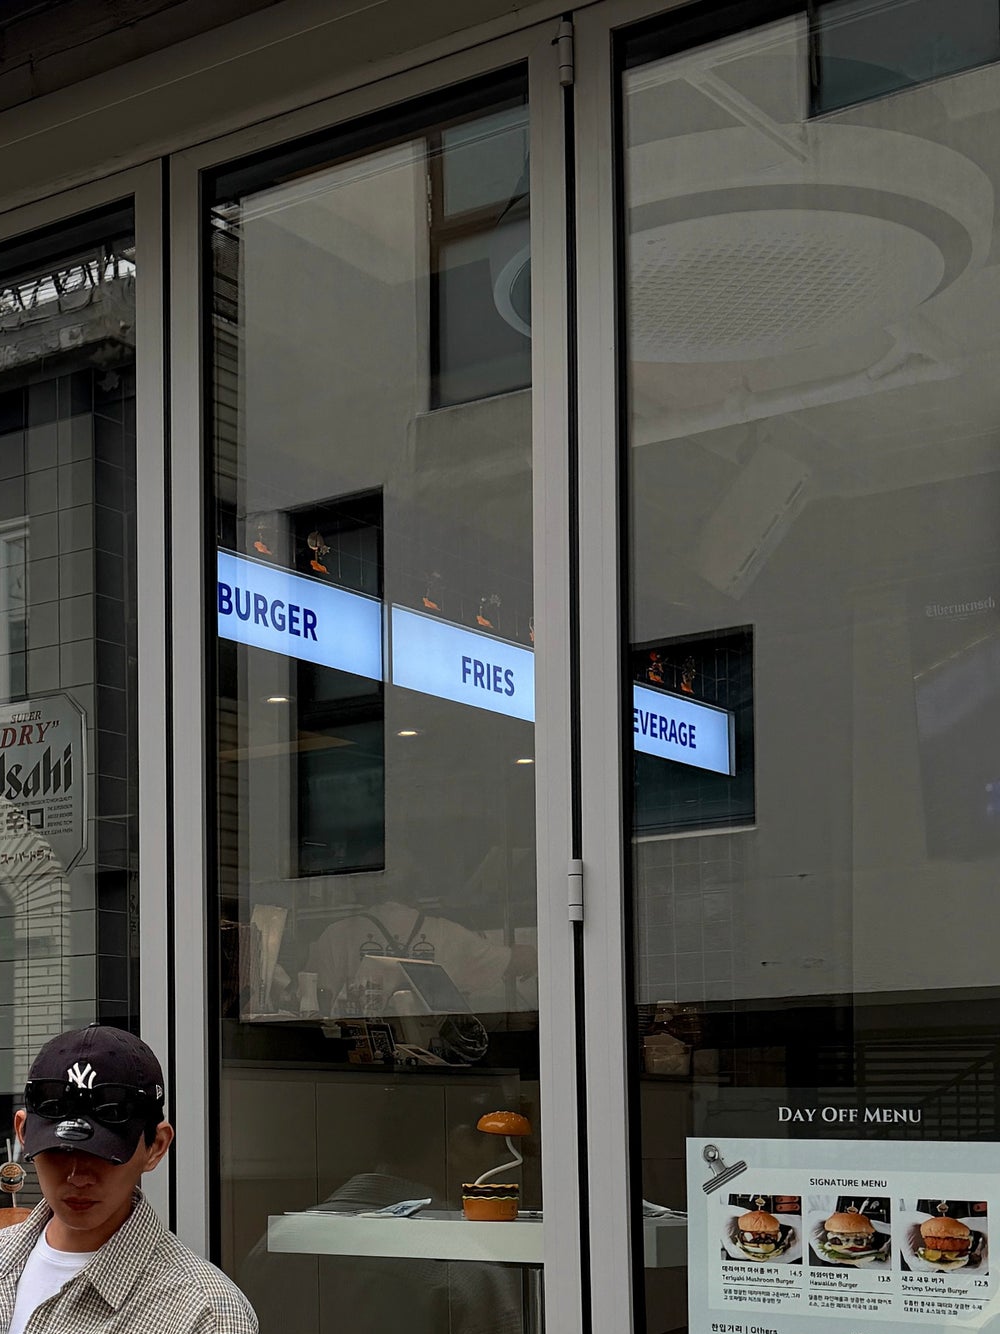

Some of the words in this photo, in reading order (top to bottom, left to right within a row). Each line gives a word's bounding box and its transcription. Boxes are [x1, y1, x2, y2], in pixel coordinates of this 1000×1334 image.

[218, 581, 318, 642] BURGER
[462, 656, 515, 697] FRIES
[10, 710, 42, 724] SUPER
[809, 1178, 859, 1187] SIGNATURE
[861, 1179, 887, 1188] MENU
[776, 1278, 794, 1286] Burger
[948, 1288, 968, 1296] Burger
[712, 1323, 742, 1333] 한입거리
[751, 1326, 777, 1334] Others
